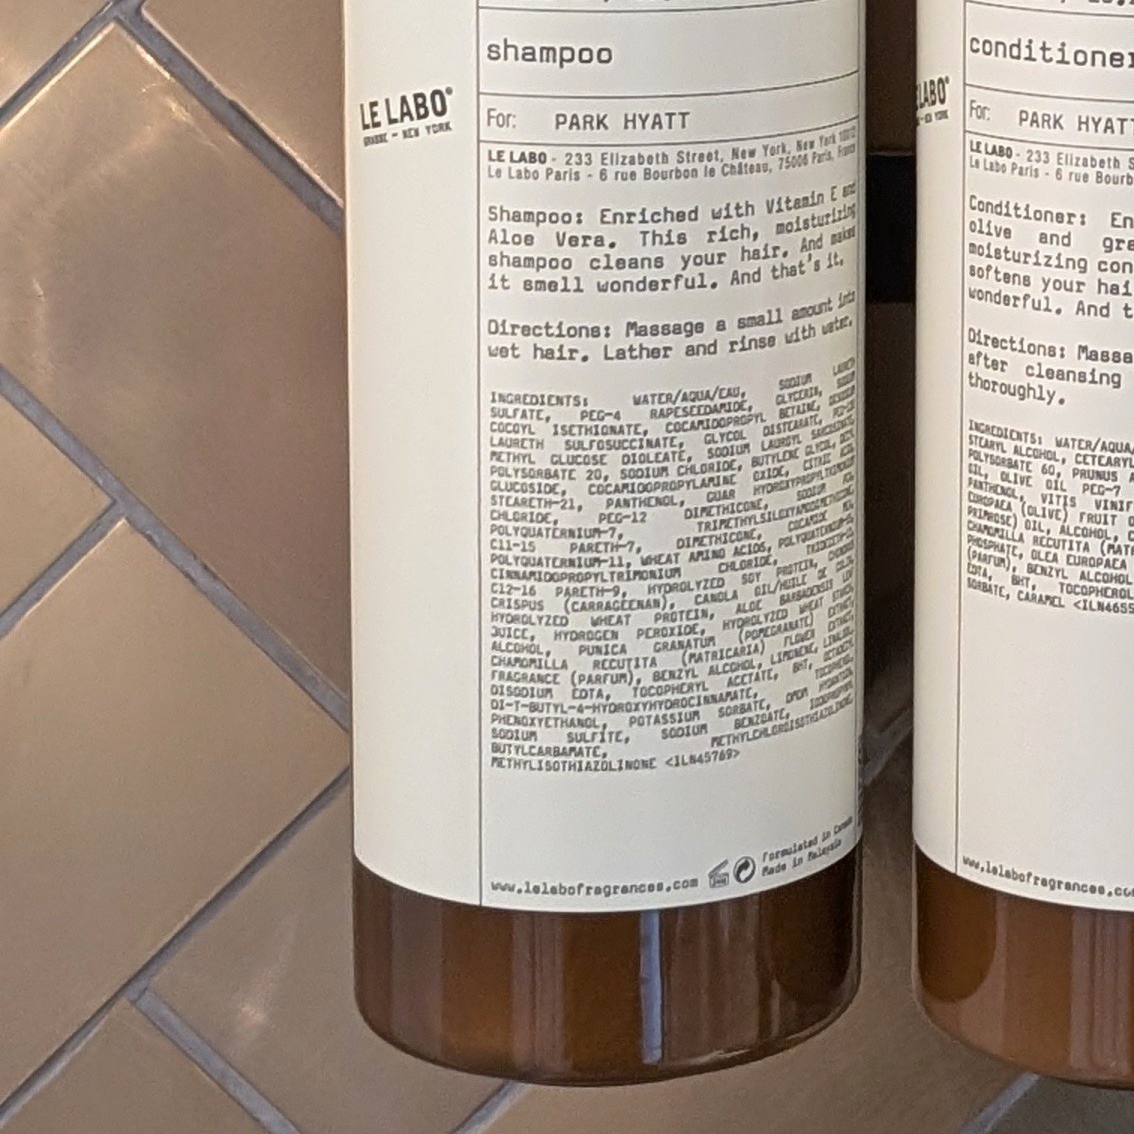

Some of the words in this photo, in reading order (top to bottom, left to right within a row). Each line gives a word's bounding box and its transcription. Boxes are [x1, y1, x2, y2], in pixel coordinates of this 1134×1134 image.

[487, 37, 612, 69] shampoo
[360, 100, 381, 130] LE
[487, 109, 516, 128] For:
[555, 113, 609, 131] PARK
[624, 111, 690, 130] HYATT
[970, 99, 990, 121] For:
[1019, 109, 1064, 130] PARK
[488, 205, 582, 227] Shampoo:
[600, 205, 698, 225] Enriched
[711, 200, 755, 224] with
[766, 190, 824, 215] Vitamin
[969, 194, 1086, 226] Conditioner:
[488, 227, 539, 246] Aloe
[556, 231, 616, 249] Vera.
[639, 229, 687, 247] This
[707, 224, 759, 248] rich,
[969, 219, 1011, 243] olive
[1039, 231, 1071, 247] and
[489, 250, 572, 273] shampoo
[589, 253, 664, 271] cleans
[681, 252, 727, 272] your
[741, 243, 788, 262] hair.
[800, 233, 824, 253] And
[969, 242, 1087, 274] moisturizing
[488, 273, 510, 290] it
[523, 270, 584, 293] smell
[597, 272, 718, 293] wonderful.
[730, 266, 761, 286] And
[771, 255, 820, 280] that's
[827, 251, 844, 269] it.
[969, 264, 1031, 288] softens
[1042, 277, 1086, 293] your
[488, 319, 611, 339] Directions:
[625, 321, 704, 338] Massage
[716, 319, 726, 332] a
[737, 307, 783, 330] small
[791, 297, 833, 321] amount
[969, 287, 1062, 315] wonderful.
[1075, 300, 1110, 318] And
